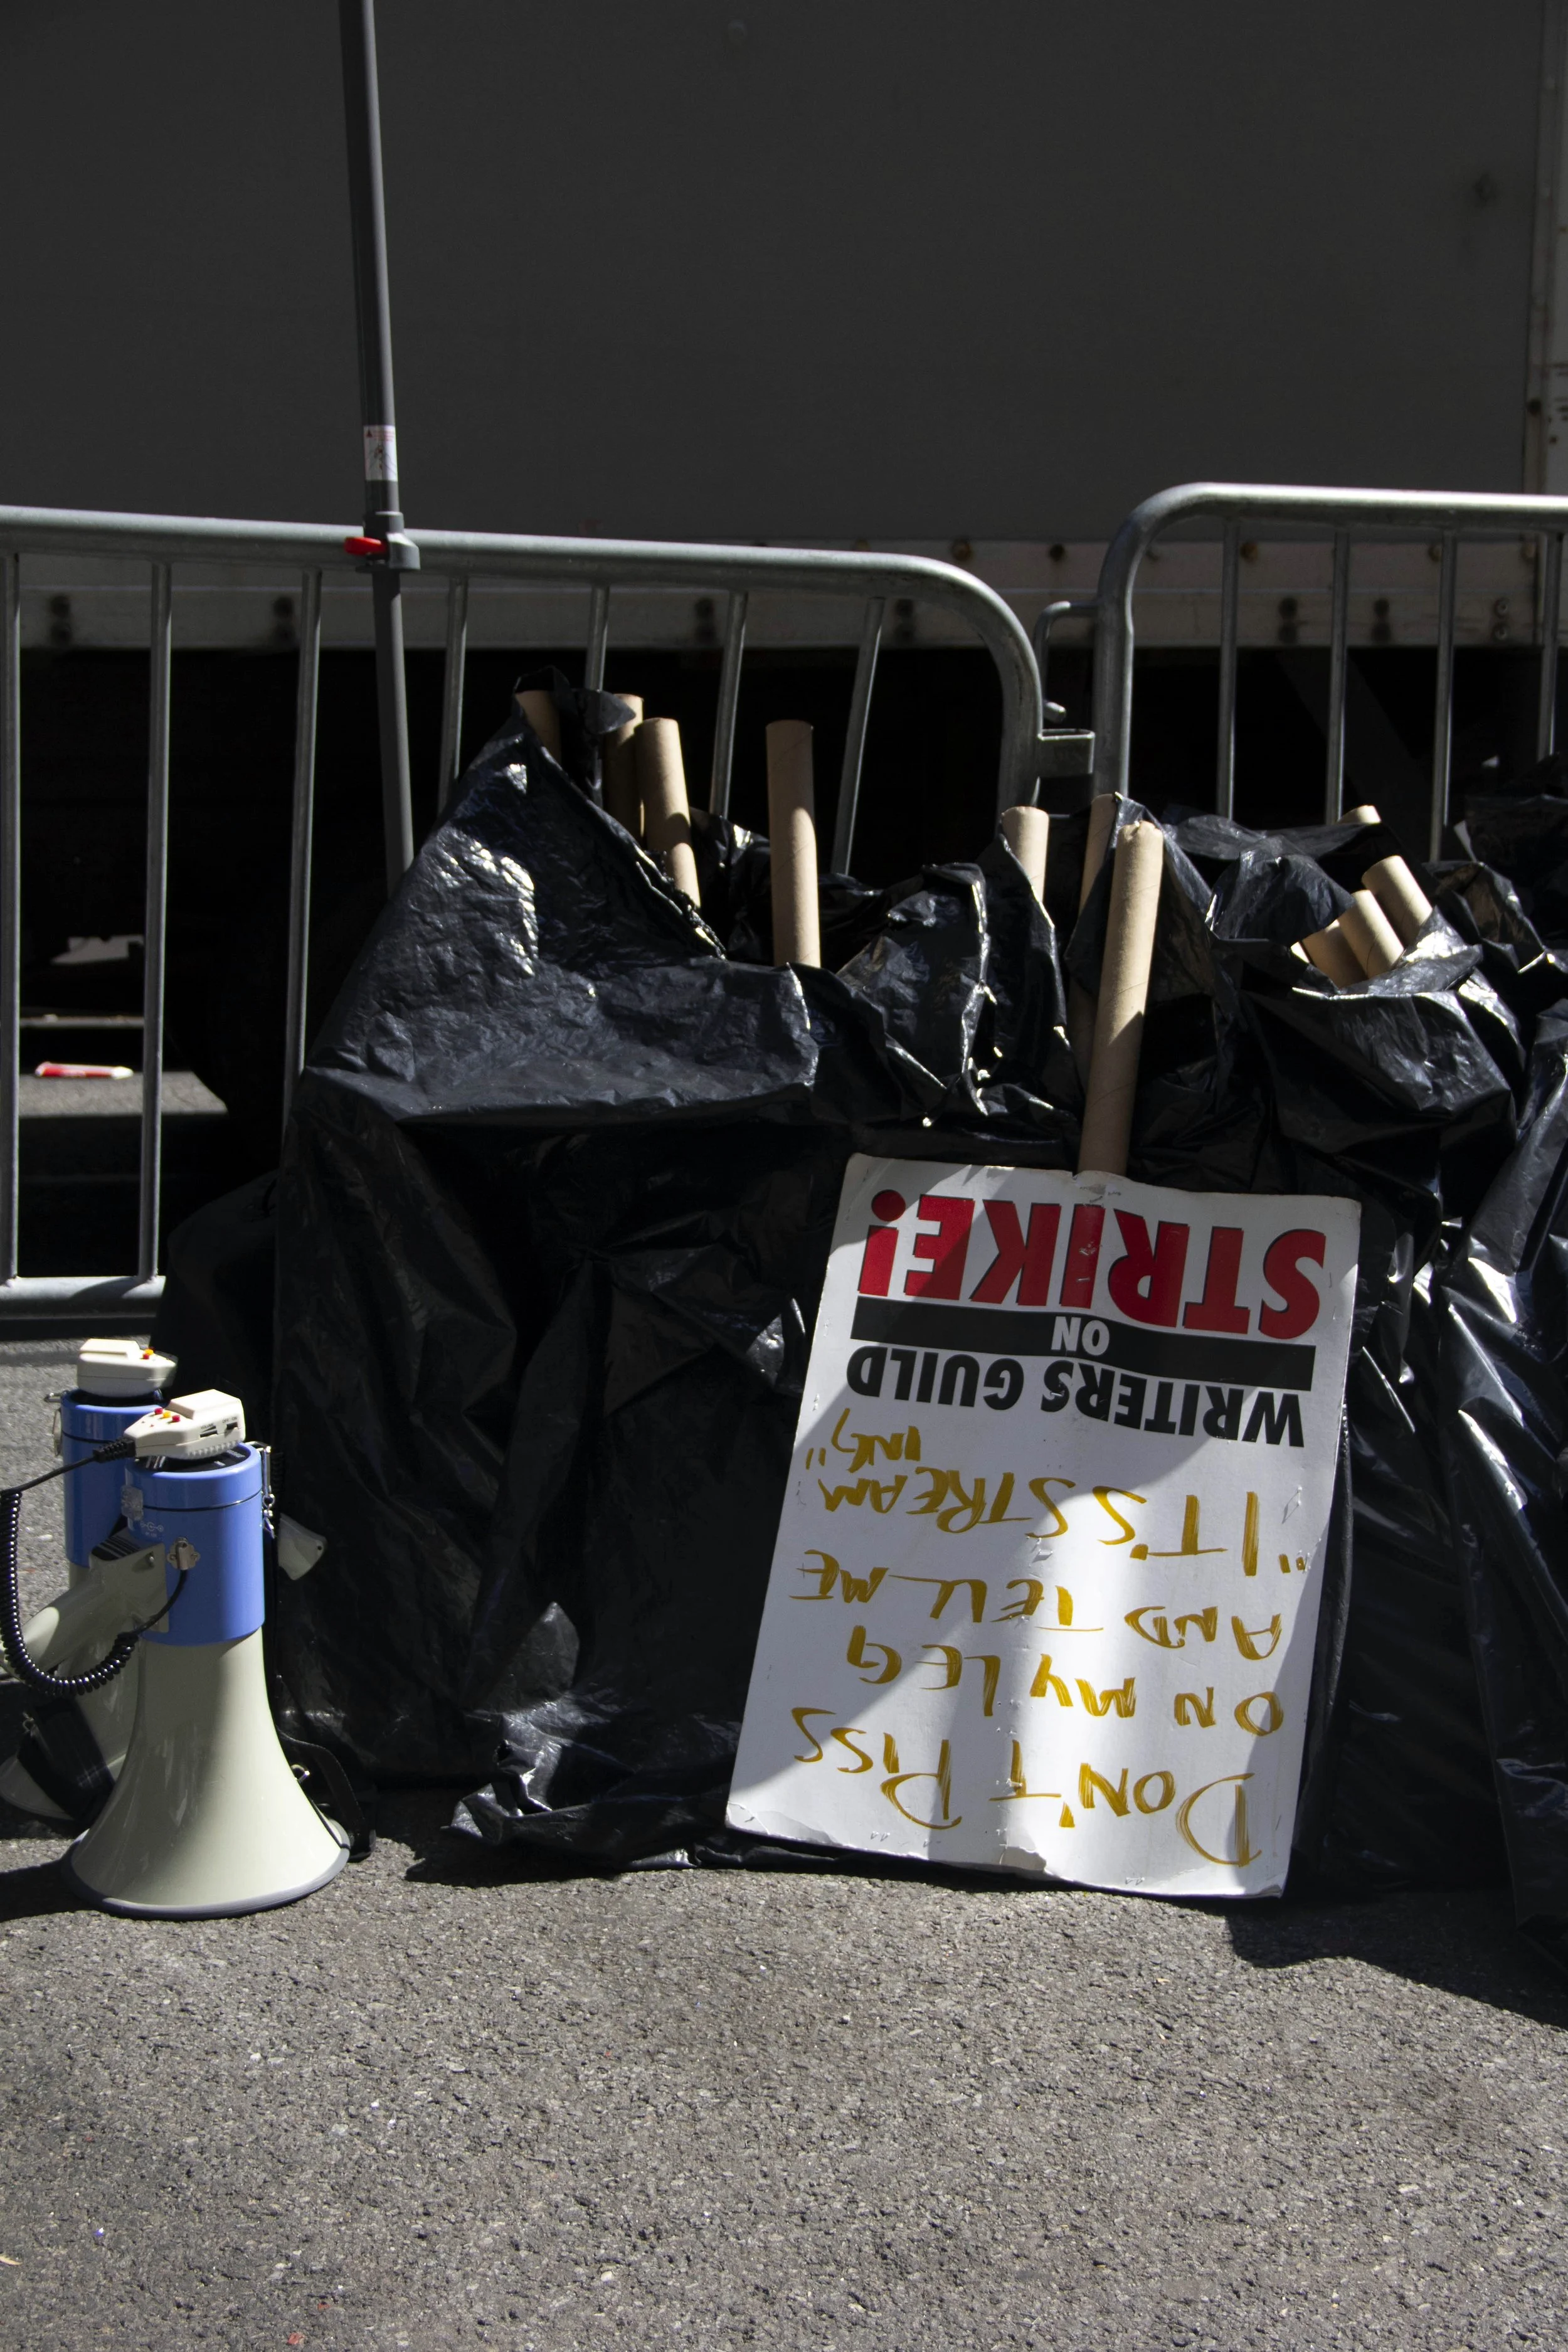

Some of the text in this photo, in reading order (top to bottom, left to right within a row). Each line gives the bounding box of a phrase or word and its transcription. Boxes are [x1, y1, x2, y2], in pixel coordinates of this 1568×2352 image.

[857, 1189, 1327, 1340] STRIKE!
[1051, 1315, 1110, 1355] ON
[806, 1407, 921, 1473] ING"
[845, 1346, 1305, 1448] WRITERS GUILD
[818, 1466, 1306, 1577] "IT'S STREAM
[790, 1549, 1282, 1661] AND TELL ME
[847, 1625, 1283, 1736] ON MY LEG
[792, 1708, 1262, 1867] DON'T PISS
